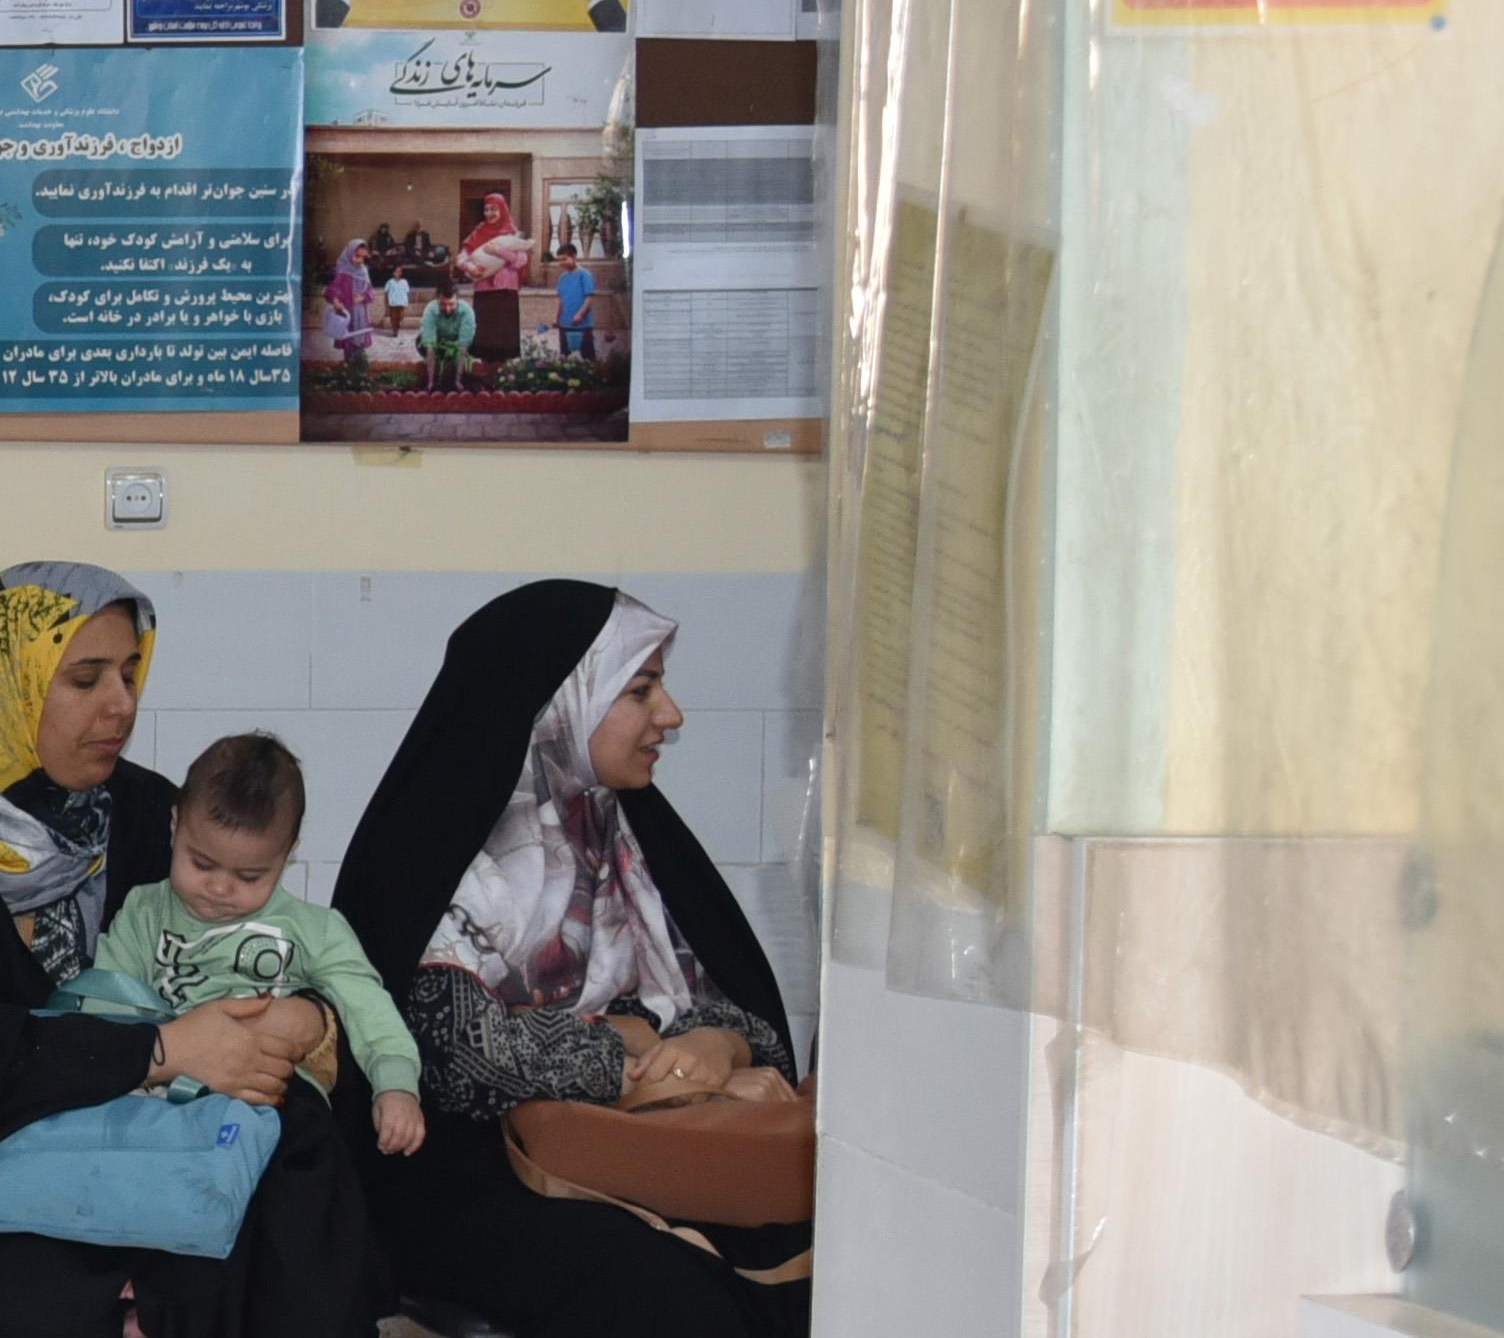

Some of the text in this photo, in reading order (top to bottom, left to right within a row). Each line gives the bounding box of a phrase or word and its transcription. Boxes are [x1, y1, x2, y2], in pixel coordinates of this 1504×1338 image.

[33, 132, 114, 159] فرزندآوری
[129, 132, 183, 158] ازدواج
[36, 183, 75, 200] نمایید.
[78, 182, 146, 201] فرزندآوری
[164, 182, 197, 199] اقدام
[249, 184, 276, 199] سنین
[94, 289, 122, 305] برای
[126, 289, 159, 304] تکامل
[174, 289, 216, 307] پرورش
[220, 288, 252, 303] محیط
[2, 344, 44, 361] مادران
[48, 344, 76, 361] برای
[81, 345, 112, 361] بعدی
[115, 344, 163, 361] بارداری
[179, 343, 205, 361] تولد
[207, 345, 228, 361] بین
[231, 344, 257, 361] ایمن
[261, 343, 292, 359] فاصله
[21, 368, 45, 386] سال
[48, 368, 69, 383] ۳۵
[88, 369, 117, 387] بالاتر
[121, 369, 162, 387] مادران
[166, 369, 194, 387] برای
[207, 369, 226, 383] ماه
